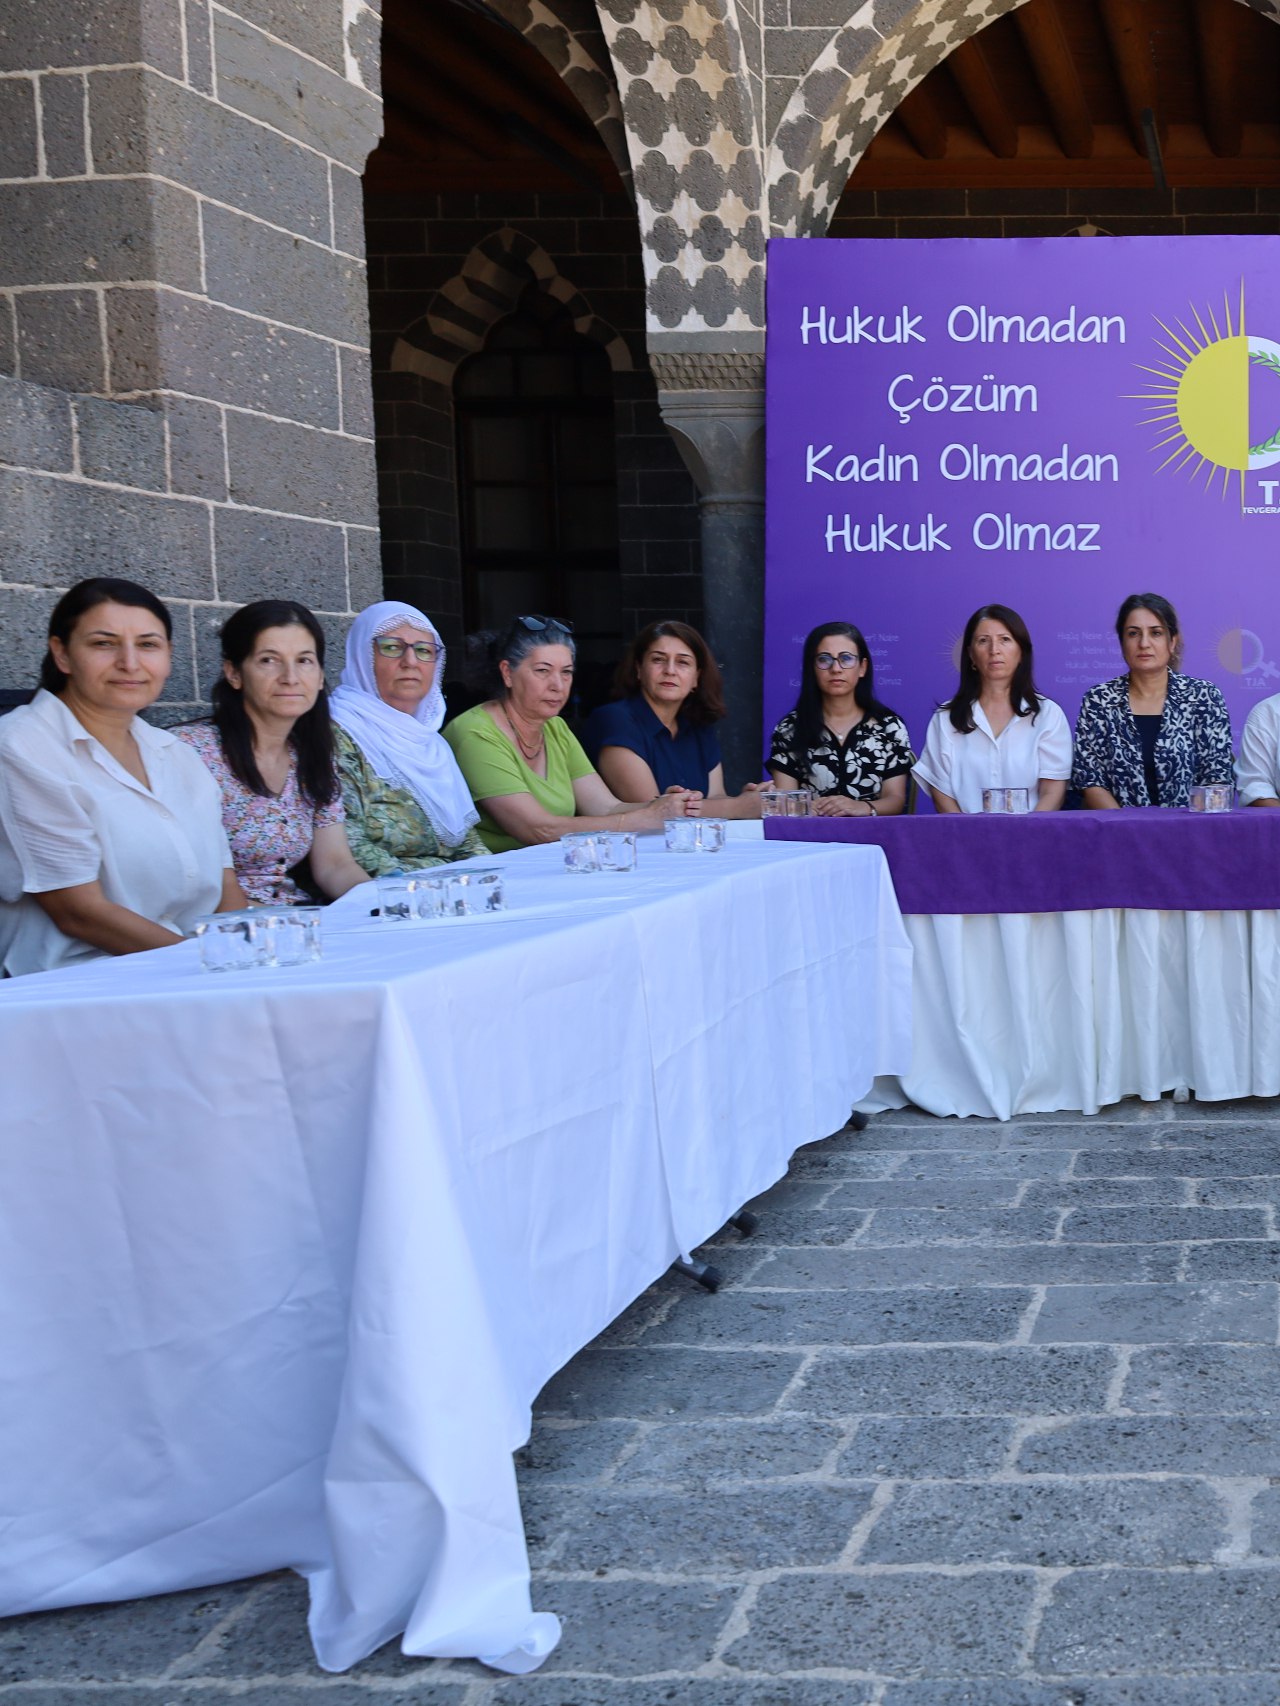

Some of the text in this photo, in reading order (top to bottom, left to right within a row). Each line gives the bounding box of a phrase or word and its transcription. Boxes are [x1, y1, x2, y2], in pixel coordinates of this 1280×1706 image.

[800, 305, 1125, 344] Hukuk Olmadan
[888, 374, 1037, 424] Çözüm
[806, 444, 1118, 482] Kadın Olmadan
[825, 513, 1101, 552] Hukuk Olmaz
